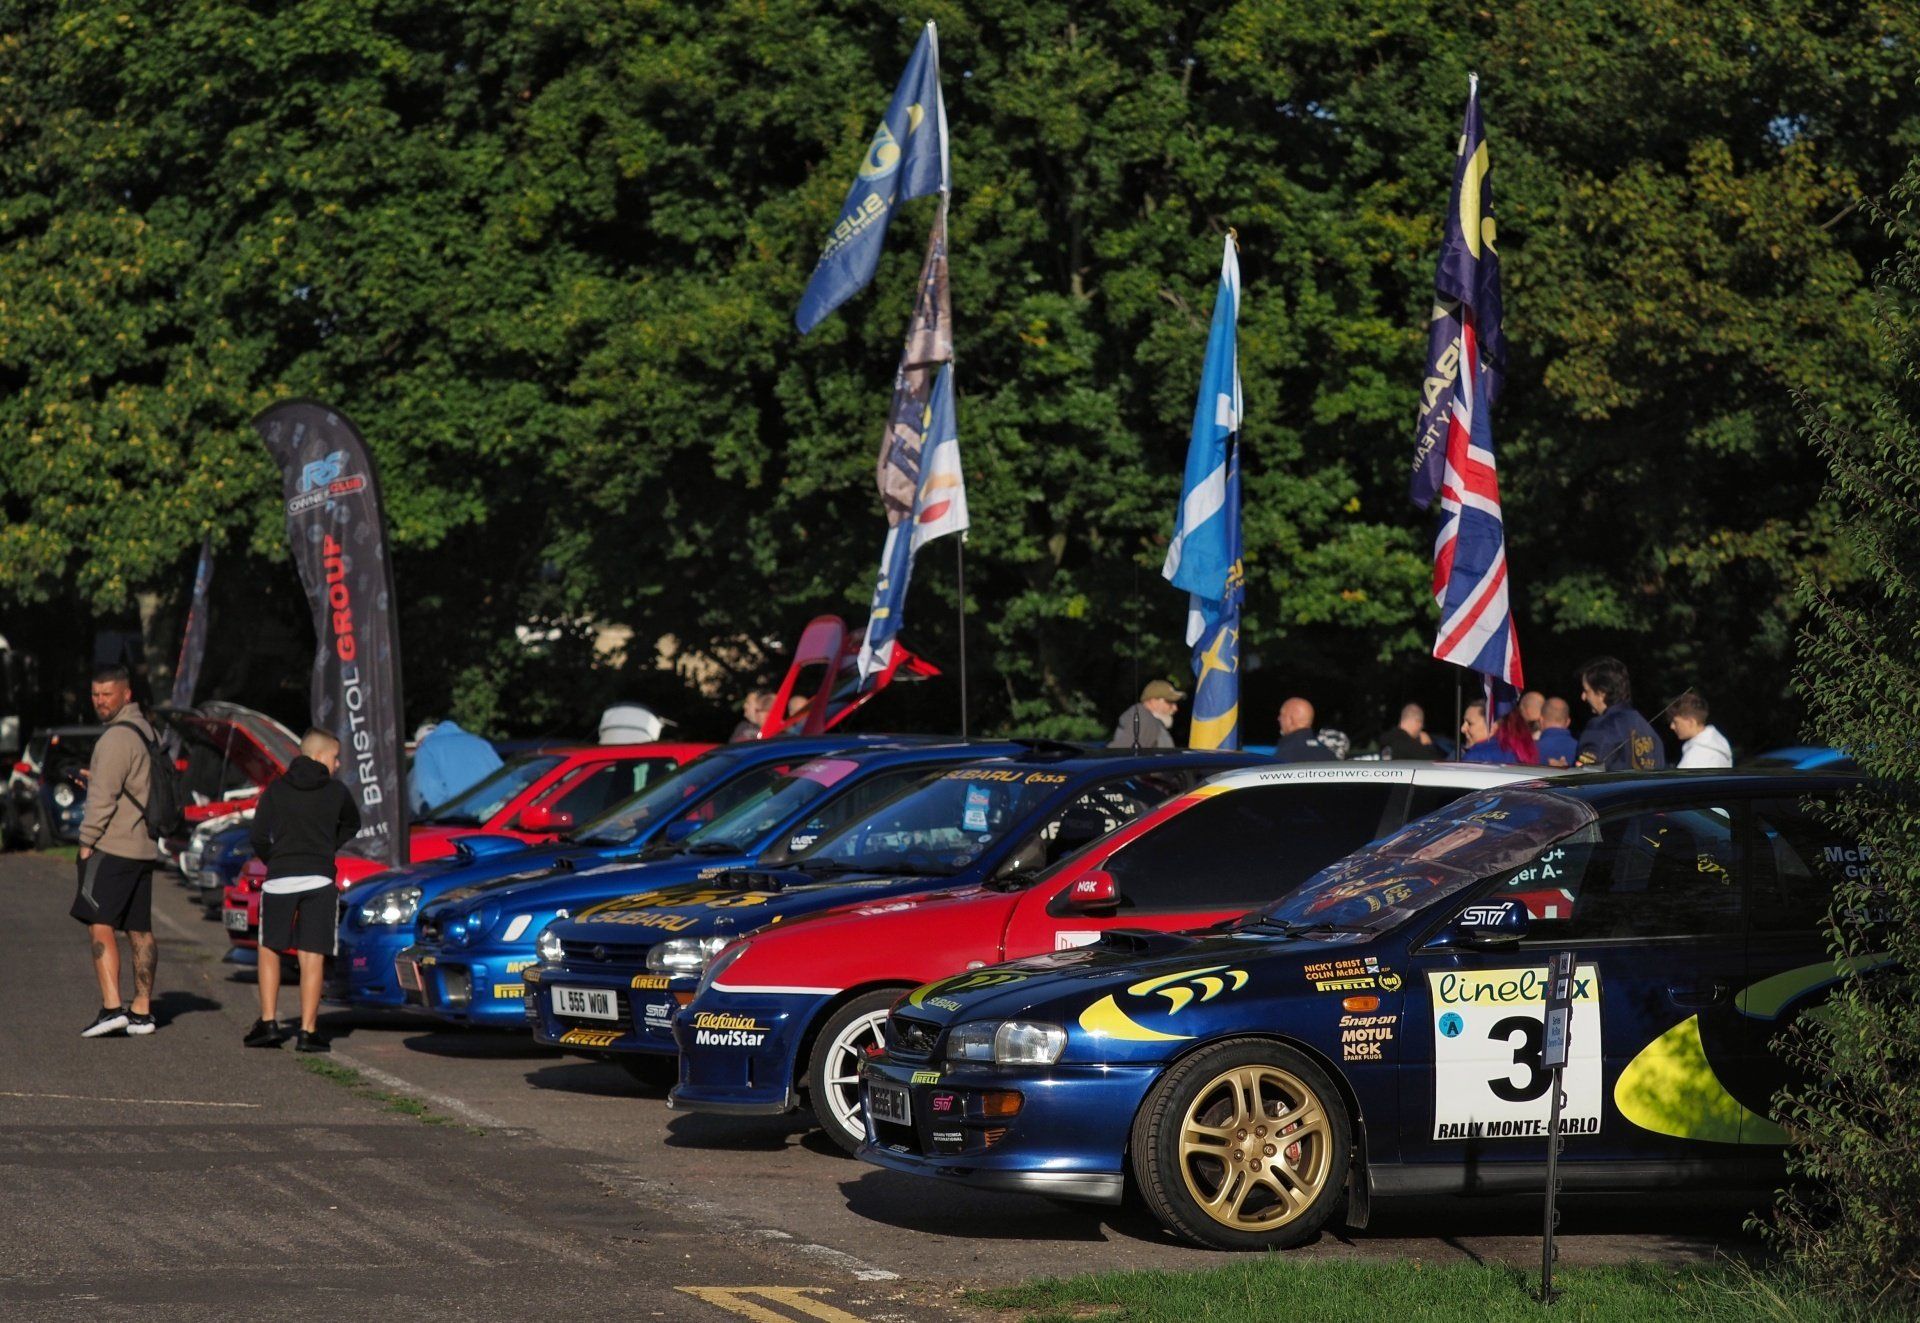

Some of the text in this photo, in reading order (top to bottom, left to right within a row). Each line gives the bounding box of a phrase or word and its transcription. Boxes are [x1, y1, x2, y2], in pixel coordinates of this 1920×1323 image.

[323, 534, 383, 806] BRISTOL GROUP
[1259, 769, 1404, 781] www.citroenwrc.com
[1541, 864, 1563, 879] A-
[1077, 881, 1097, 892] NGK
[589, 910, 700, 932] SUBARU
[1304, 959, 1361, 973] NICKY GRIST
[1306, 970, 1334, 980] COLIN
[1336, 967, 1366, 977] McRAE
[630, 974, 671, 989] PIRELLI
[1315, 977, 1376, 991] PIRELLI
[1383, 977, 1397, 986] 100
[560, 990, 565, 1011] L
[568, 991, 585, 1012] 555
[927, 996, 962, 1012] SUBARU
[1339, 1015, 1397, 1027] Snap-on
[1446, 1021, 1459, 1035] A
[560, 1027, 626, 1046] PIRELLI
[695, 1030, 765, 1047] MoviStar
[1341, 1028, 1393, 1042] MOTUL
[1343, 1042, 1381, 1055] NGK
[1487, 1015, 1553, 1102] 3
[911, 1071, 941, 1085] PIRELLI
[1438, 1117, 1598, 1139] RALLY MONTE-ARLO
